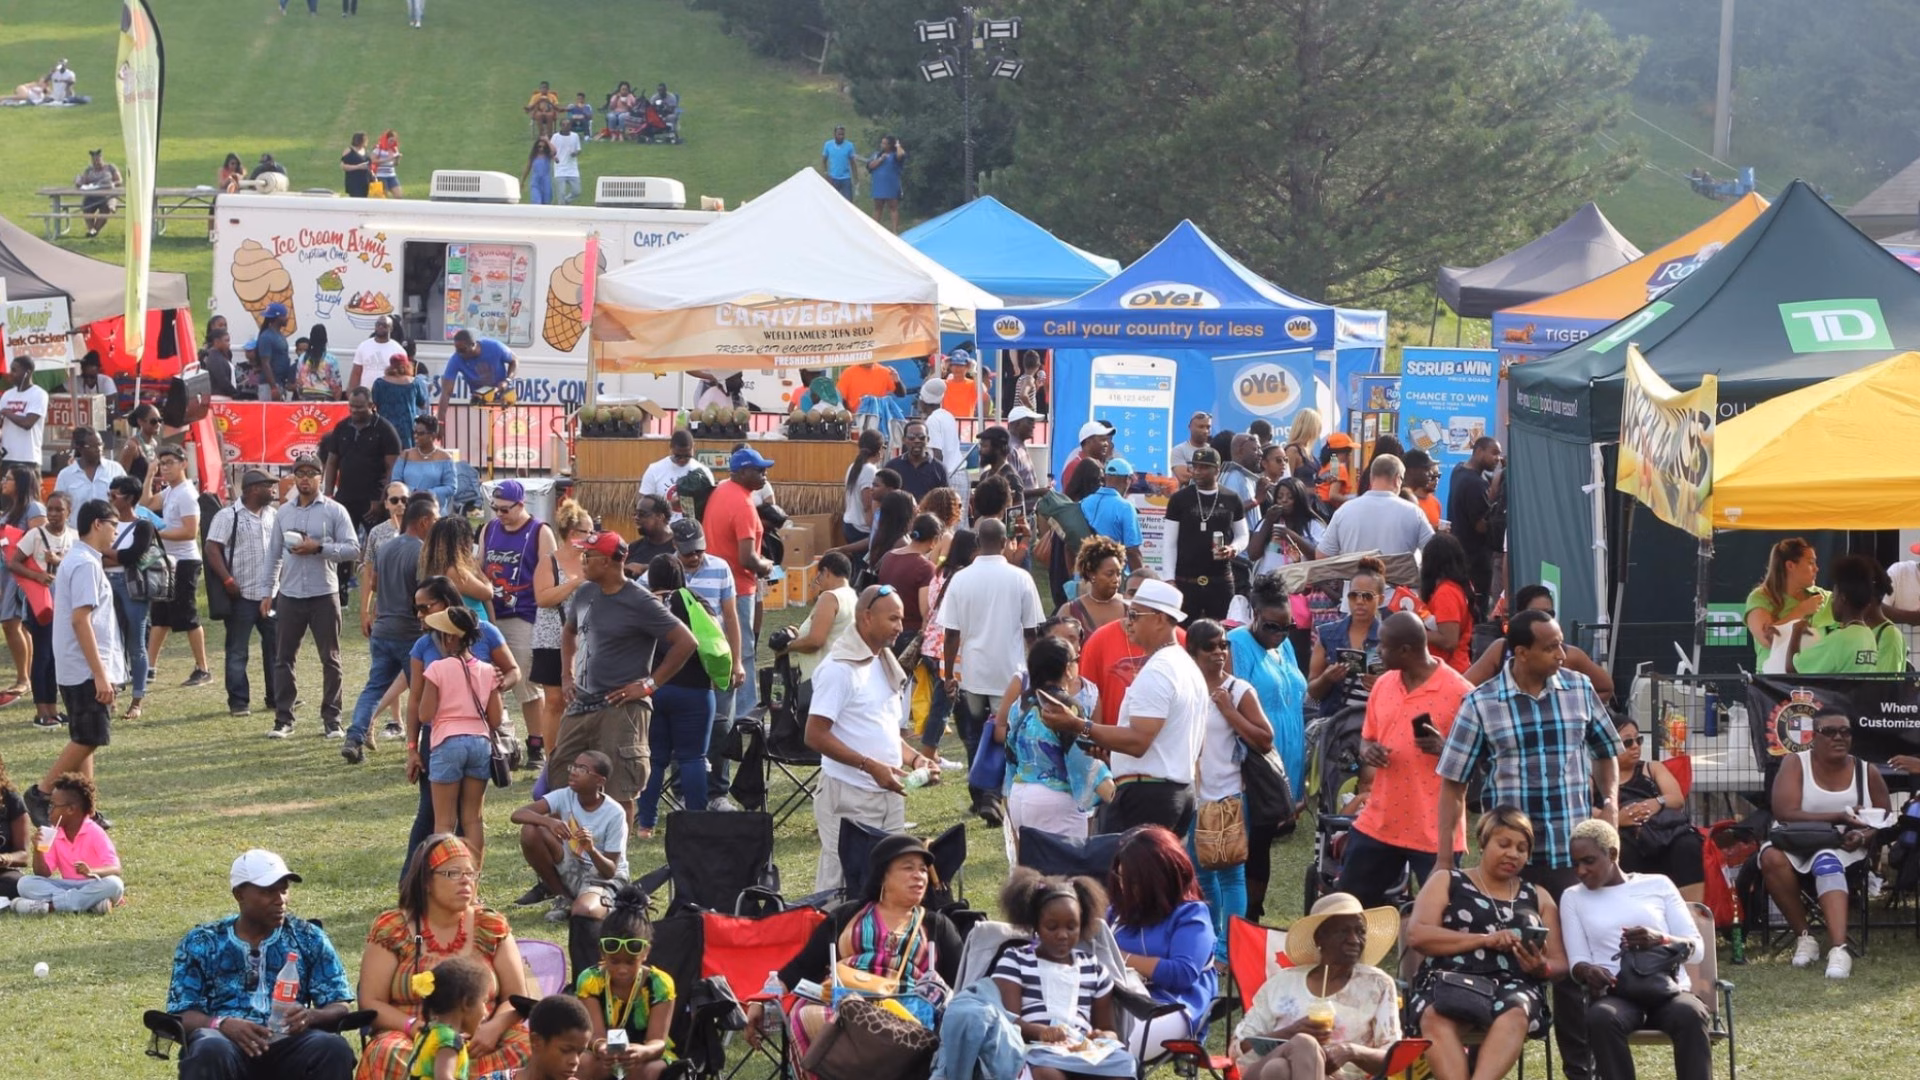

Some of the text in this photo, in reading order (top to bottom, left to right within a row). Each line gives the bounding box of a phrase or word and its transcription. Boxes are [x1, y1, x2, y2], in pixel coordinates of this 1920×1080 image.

[271, 228, 390, 269] Ice Cream Army
[298, 246, 349, 264] Captain Cone
[715, 302, 873, 328] CARIVEGAN
[1043, 320, 1264, 339] Call your country for less
[1792, 309, 1877, 342] TD
[6, 332, 68, 347] Jerk Chicken
[793, 330, 827, 340] FAMOUS
[715, 340, 876, 354] FRESH CUT COCONUT WATER
[774, 355, 821, 366] FRESHNESS
[1406, 361, 1454, 375] SCRUB
[1463, 361, 1492, 376] WIN
[1405, 392, 1489, 403] CHANCE TO WIN
[53, 411, 87, 424] FOD
[1707, 611, 1742, 636] TD
[1797, 705, 1815, 716] GRO
[1880, 702, 1918, 713] Where
